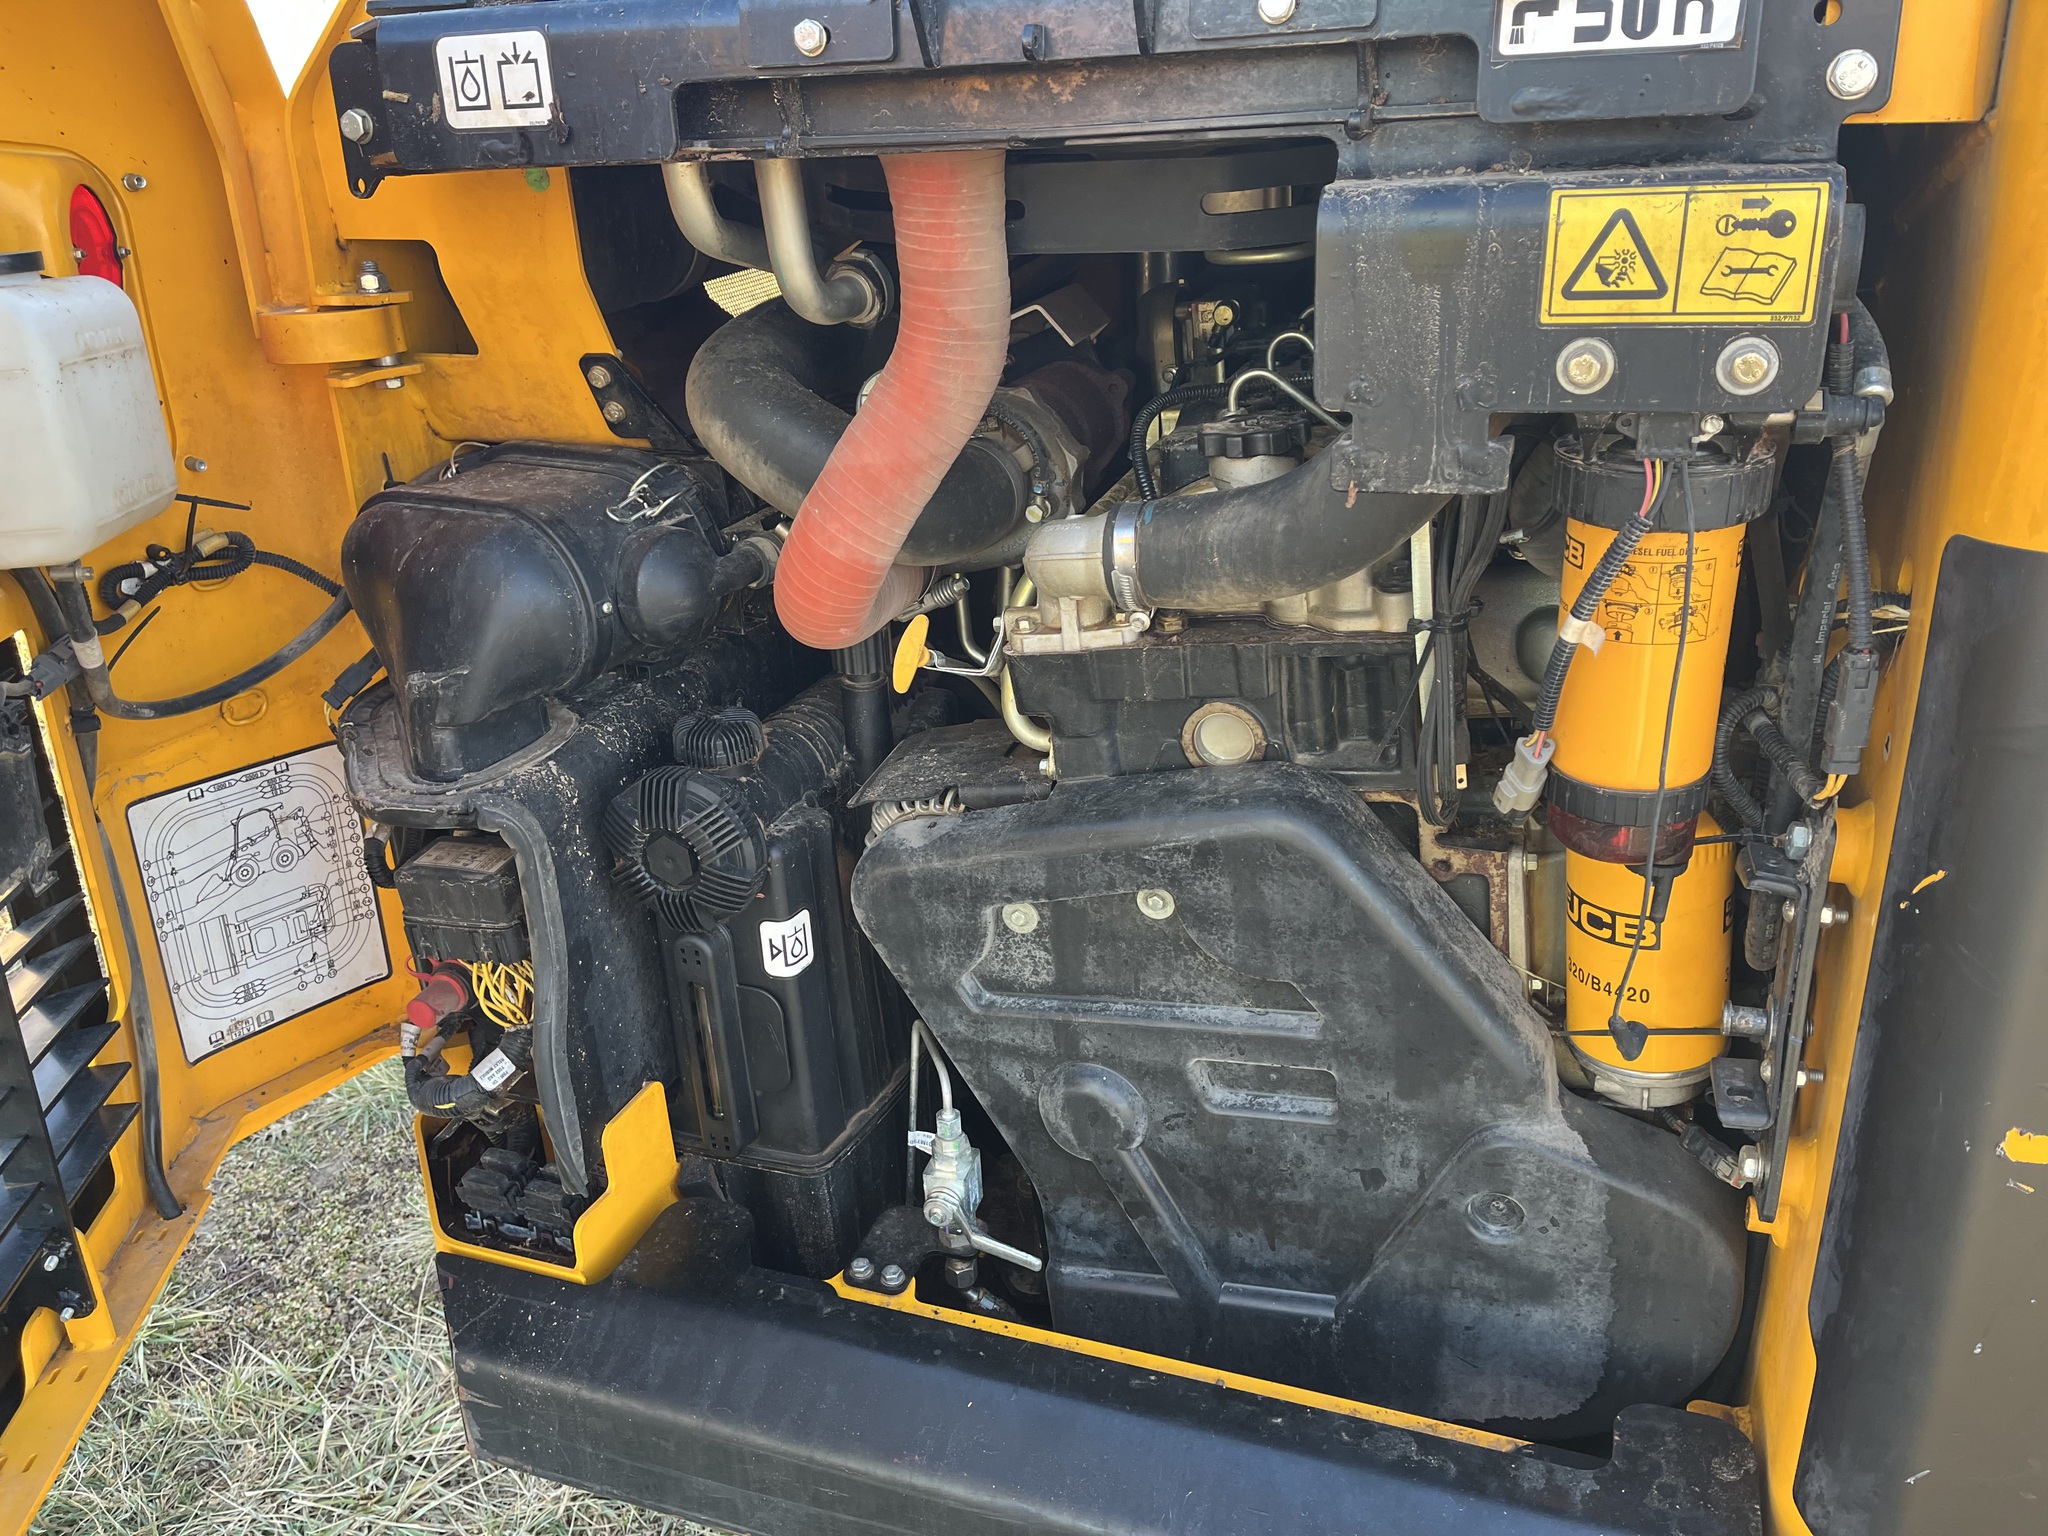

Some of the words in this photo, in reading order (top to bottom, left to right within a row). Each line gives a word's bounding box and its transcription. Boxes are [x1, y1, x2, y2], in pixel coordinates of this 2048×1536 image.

[1656, 548, 1677, 557] FUEL
[1815, 601, 1832, 644] Imperial
[1828, 562, 1841, 590] Auto
